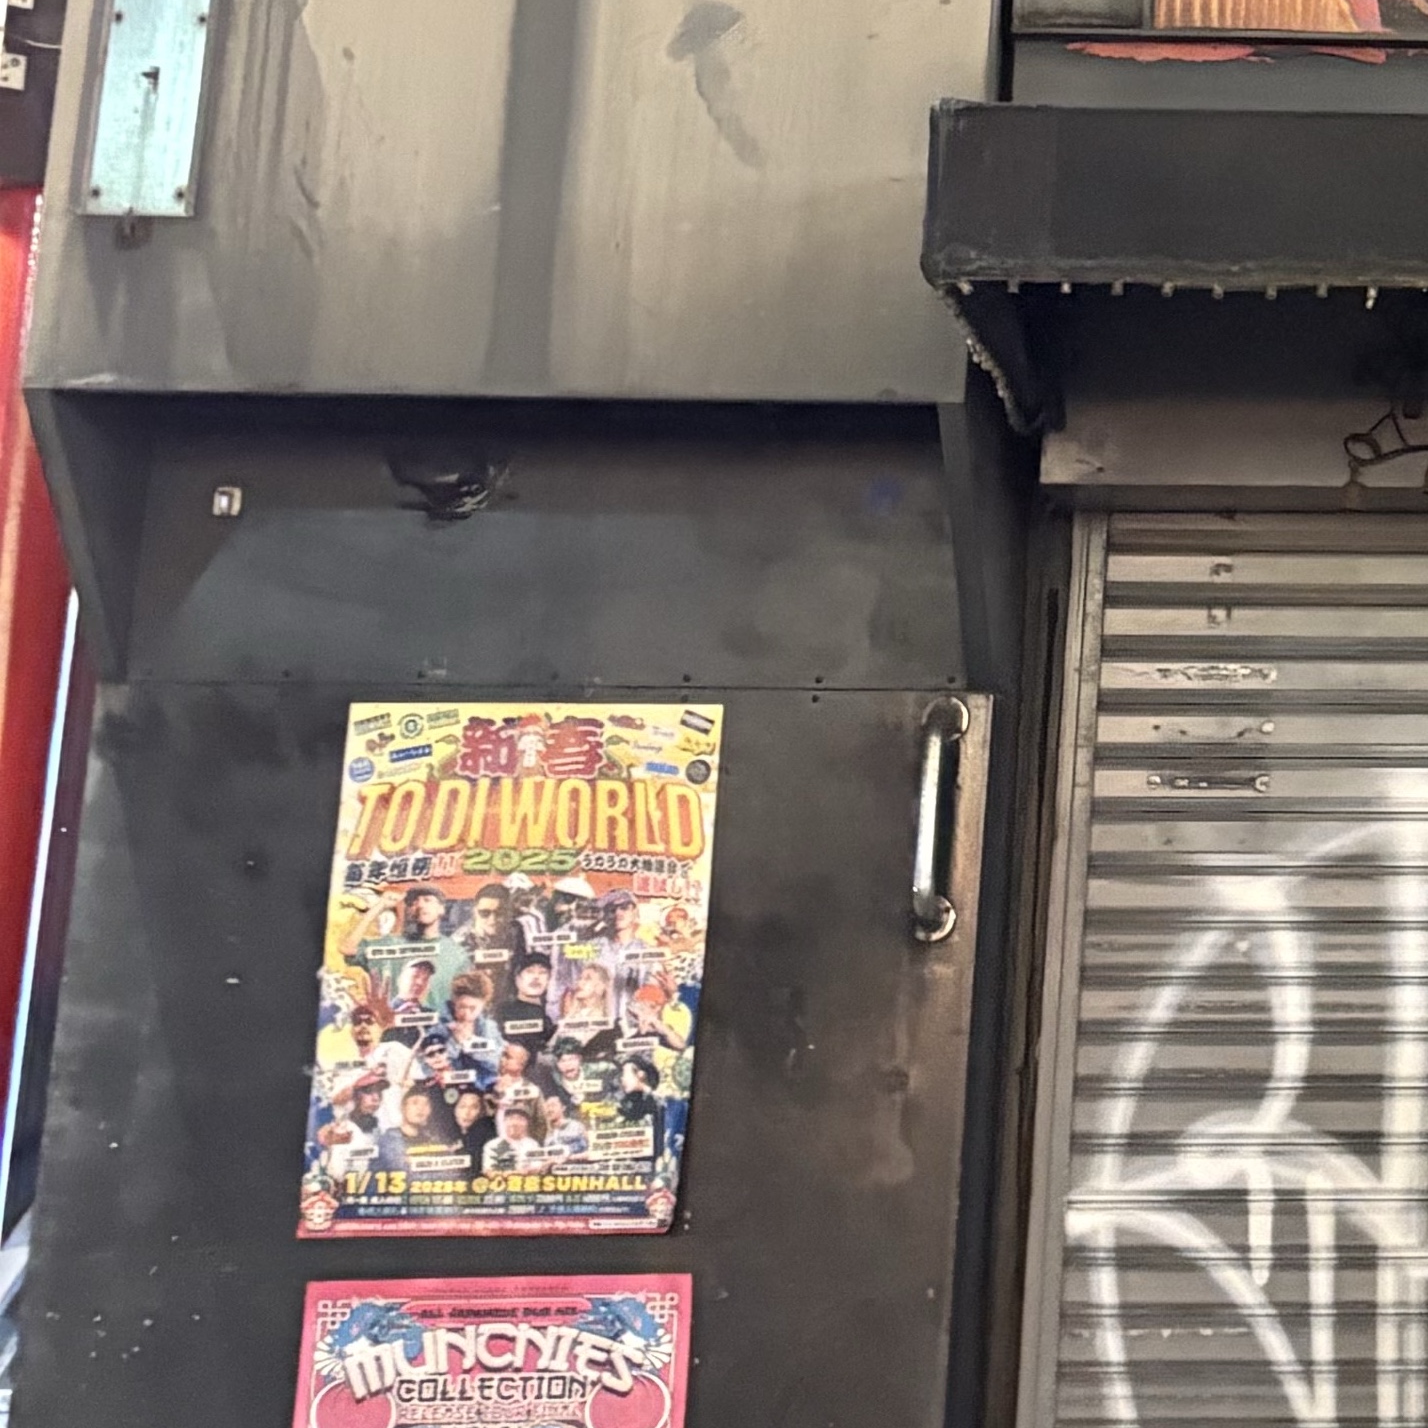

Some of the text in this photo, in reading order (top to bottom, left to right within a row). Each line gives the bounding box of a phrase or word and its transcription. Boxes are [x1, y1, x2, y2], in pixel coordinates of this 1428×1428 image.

[456, 714, 606, 778] 新春
[463, 848, 578, 874] 2025
[344, 1171, 407, 1193] 1/13
[396, 1374, 588, 1402] COLLECTION
